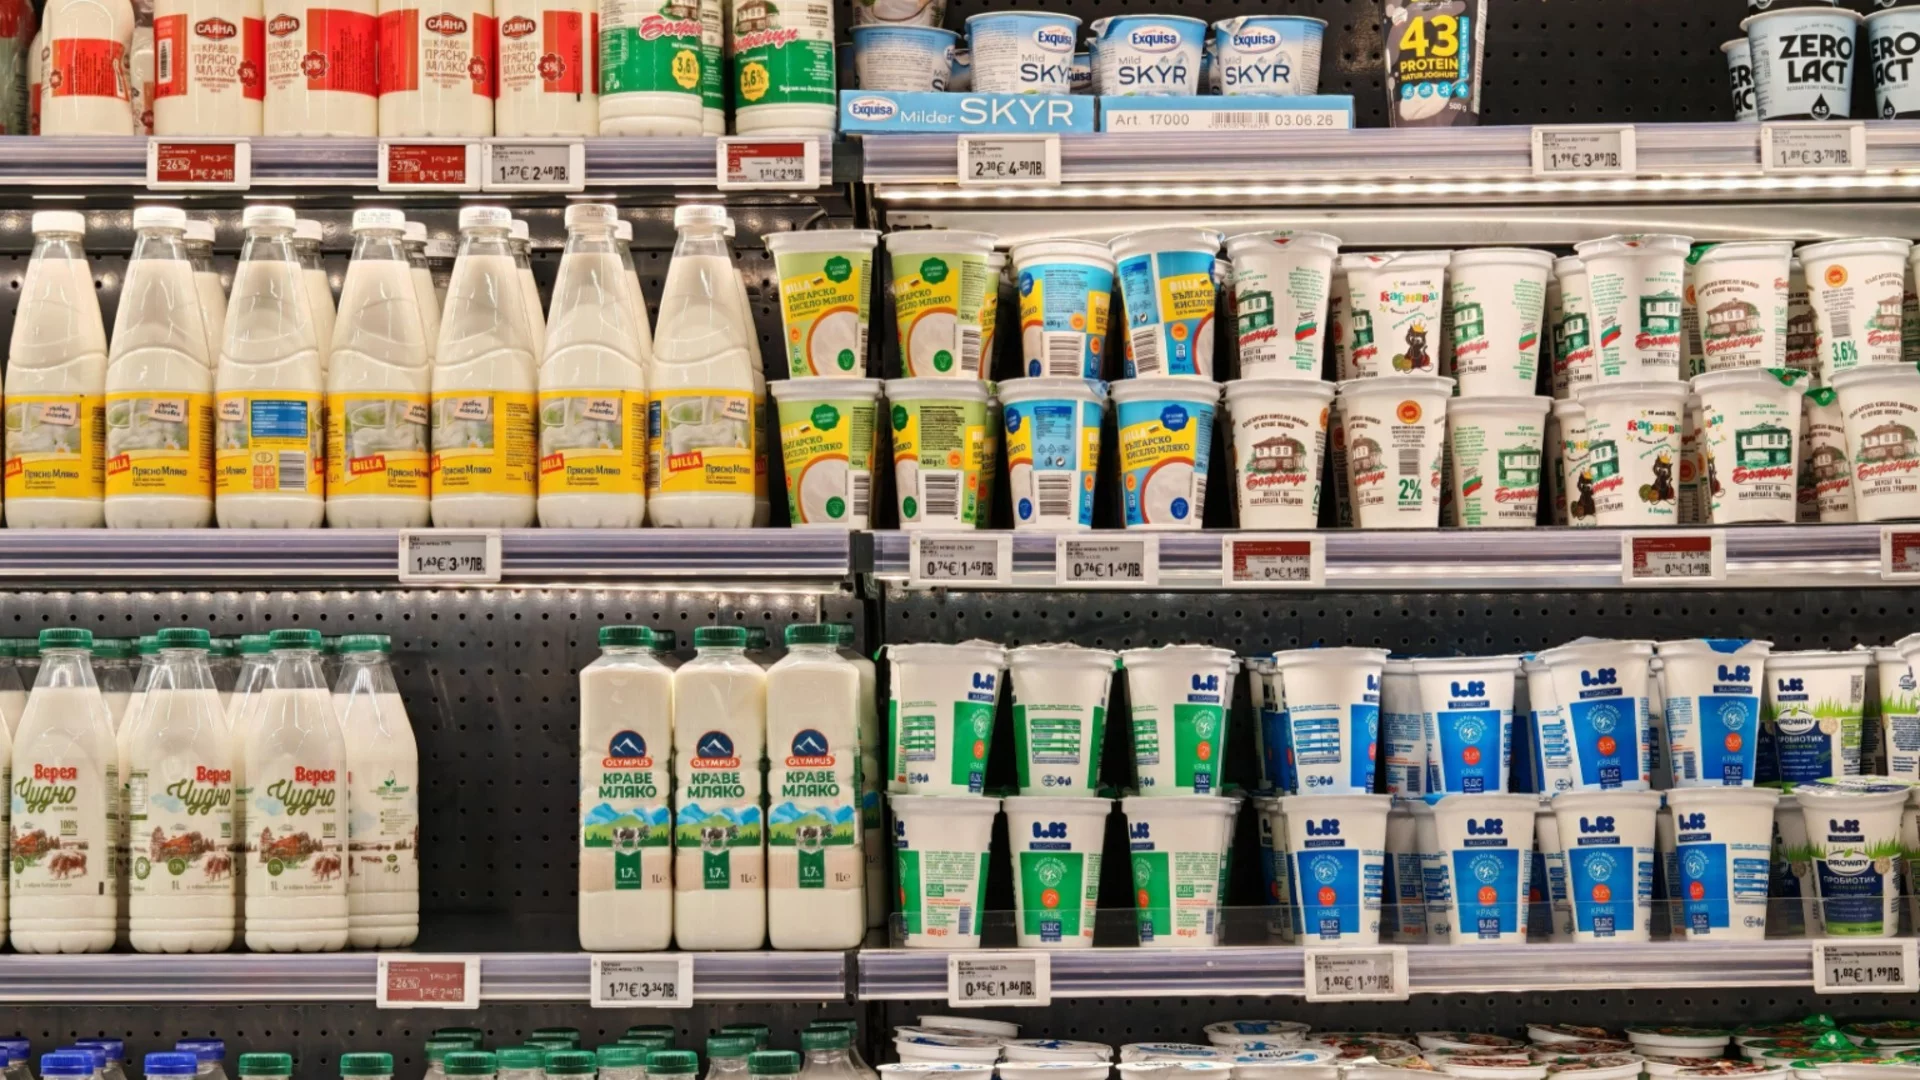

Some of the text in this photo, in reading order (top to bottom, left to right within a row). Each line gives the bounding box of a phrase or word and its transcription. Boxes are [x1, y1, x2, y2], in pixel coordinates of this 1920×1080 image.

[1132, 34, 1176, 47] Exquisa
[1233, 34, 1276, 47] Exquisa
[1399, 14, 1459, 57] 43
[1778, 34, 1853, 60] ZERO
[195, 53, 237, 66] ПРЯСНО
[425, 49, 467, 60] ПРЯСНО
[1022, 54, 1046, 62] Mild
[1119, 56, 1141, 65] Mild
[426, 61, 466, 74] МЛЯКО
[543, 62, 559, 73] 3%
[1400, 58, 1459, 73] PROTEIN
[1020, 63, 1071, 83] SKY
[1118, 65, 1187, 85] SKYR
[1225, 64, 1290, 85] SKYR
[1401, 72, 1458, 81] NATURJOGHURT
[1788, 60, 1848, 84] LACT
[853, 98, 1073, 126] Exquisa Milder SKYR
[1449, 102, 1467, 113] 500 g
[1115, 114, 1190, 126] Art. 17000
[1275, 114, 1334, 126] 03.06.26
[823, 294, 854, 306] МЛЯКО
[1832, 340, 1858, 362] 3,6%
[810, 442, 842, 454] МЛЯКО
[1158, 444, 1190, 454] МЛЯКО
[352, 457, 383, 472] BILLA
[670, 455, 701, 468] BILLA
[1857, 460, 1920, 480] Боженци
[1246, 472, 1306, 491] Боженци
[1398, 479, 1422, 500] 2%
[606, 758, 650, 767] OLYMPUS
[693, 758, 736, 767] OLYMPUS
[788, 756, 832, 766] OLYMPUS
[34, 764, 77, 785] Верея
[196, 766, 231, 786] Верея
[1600, 769, 1619, 778] БДС
[1724, 766, 1741, 774] БДС
[294, 766, 336, 787] Верея
[603, 772, 652, 784] КРАВЕ
[692, 772, 740, 784] КРАВЕ
[786, 772, 835, 783] КРАВЕ
[1464, 778, 1482, 787] БДС
[14, 776, 77, 814] Чудно
[167, 778, 230, 816] Чудно
[267, 778, 336, 816] Чудно
[598, 786, 656, 798] МЛЯКО
[688, 786, 744, 798] МЛЯКО
[782, 785, 839, 798] МЛЯКО
[60, 820, 78, 829] 100%
[1824, 876, 1876, 885] ПРОБИОТИК
[1479, 919, 1498, 928] БДС
[1594, 918, 1612, 926] БДС
